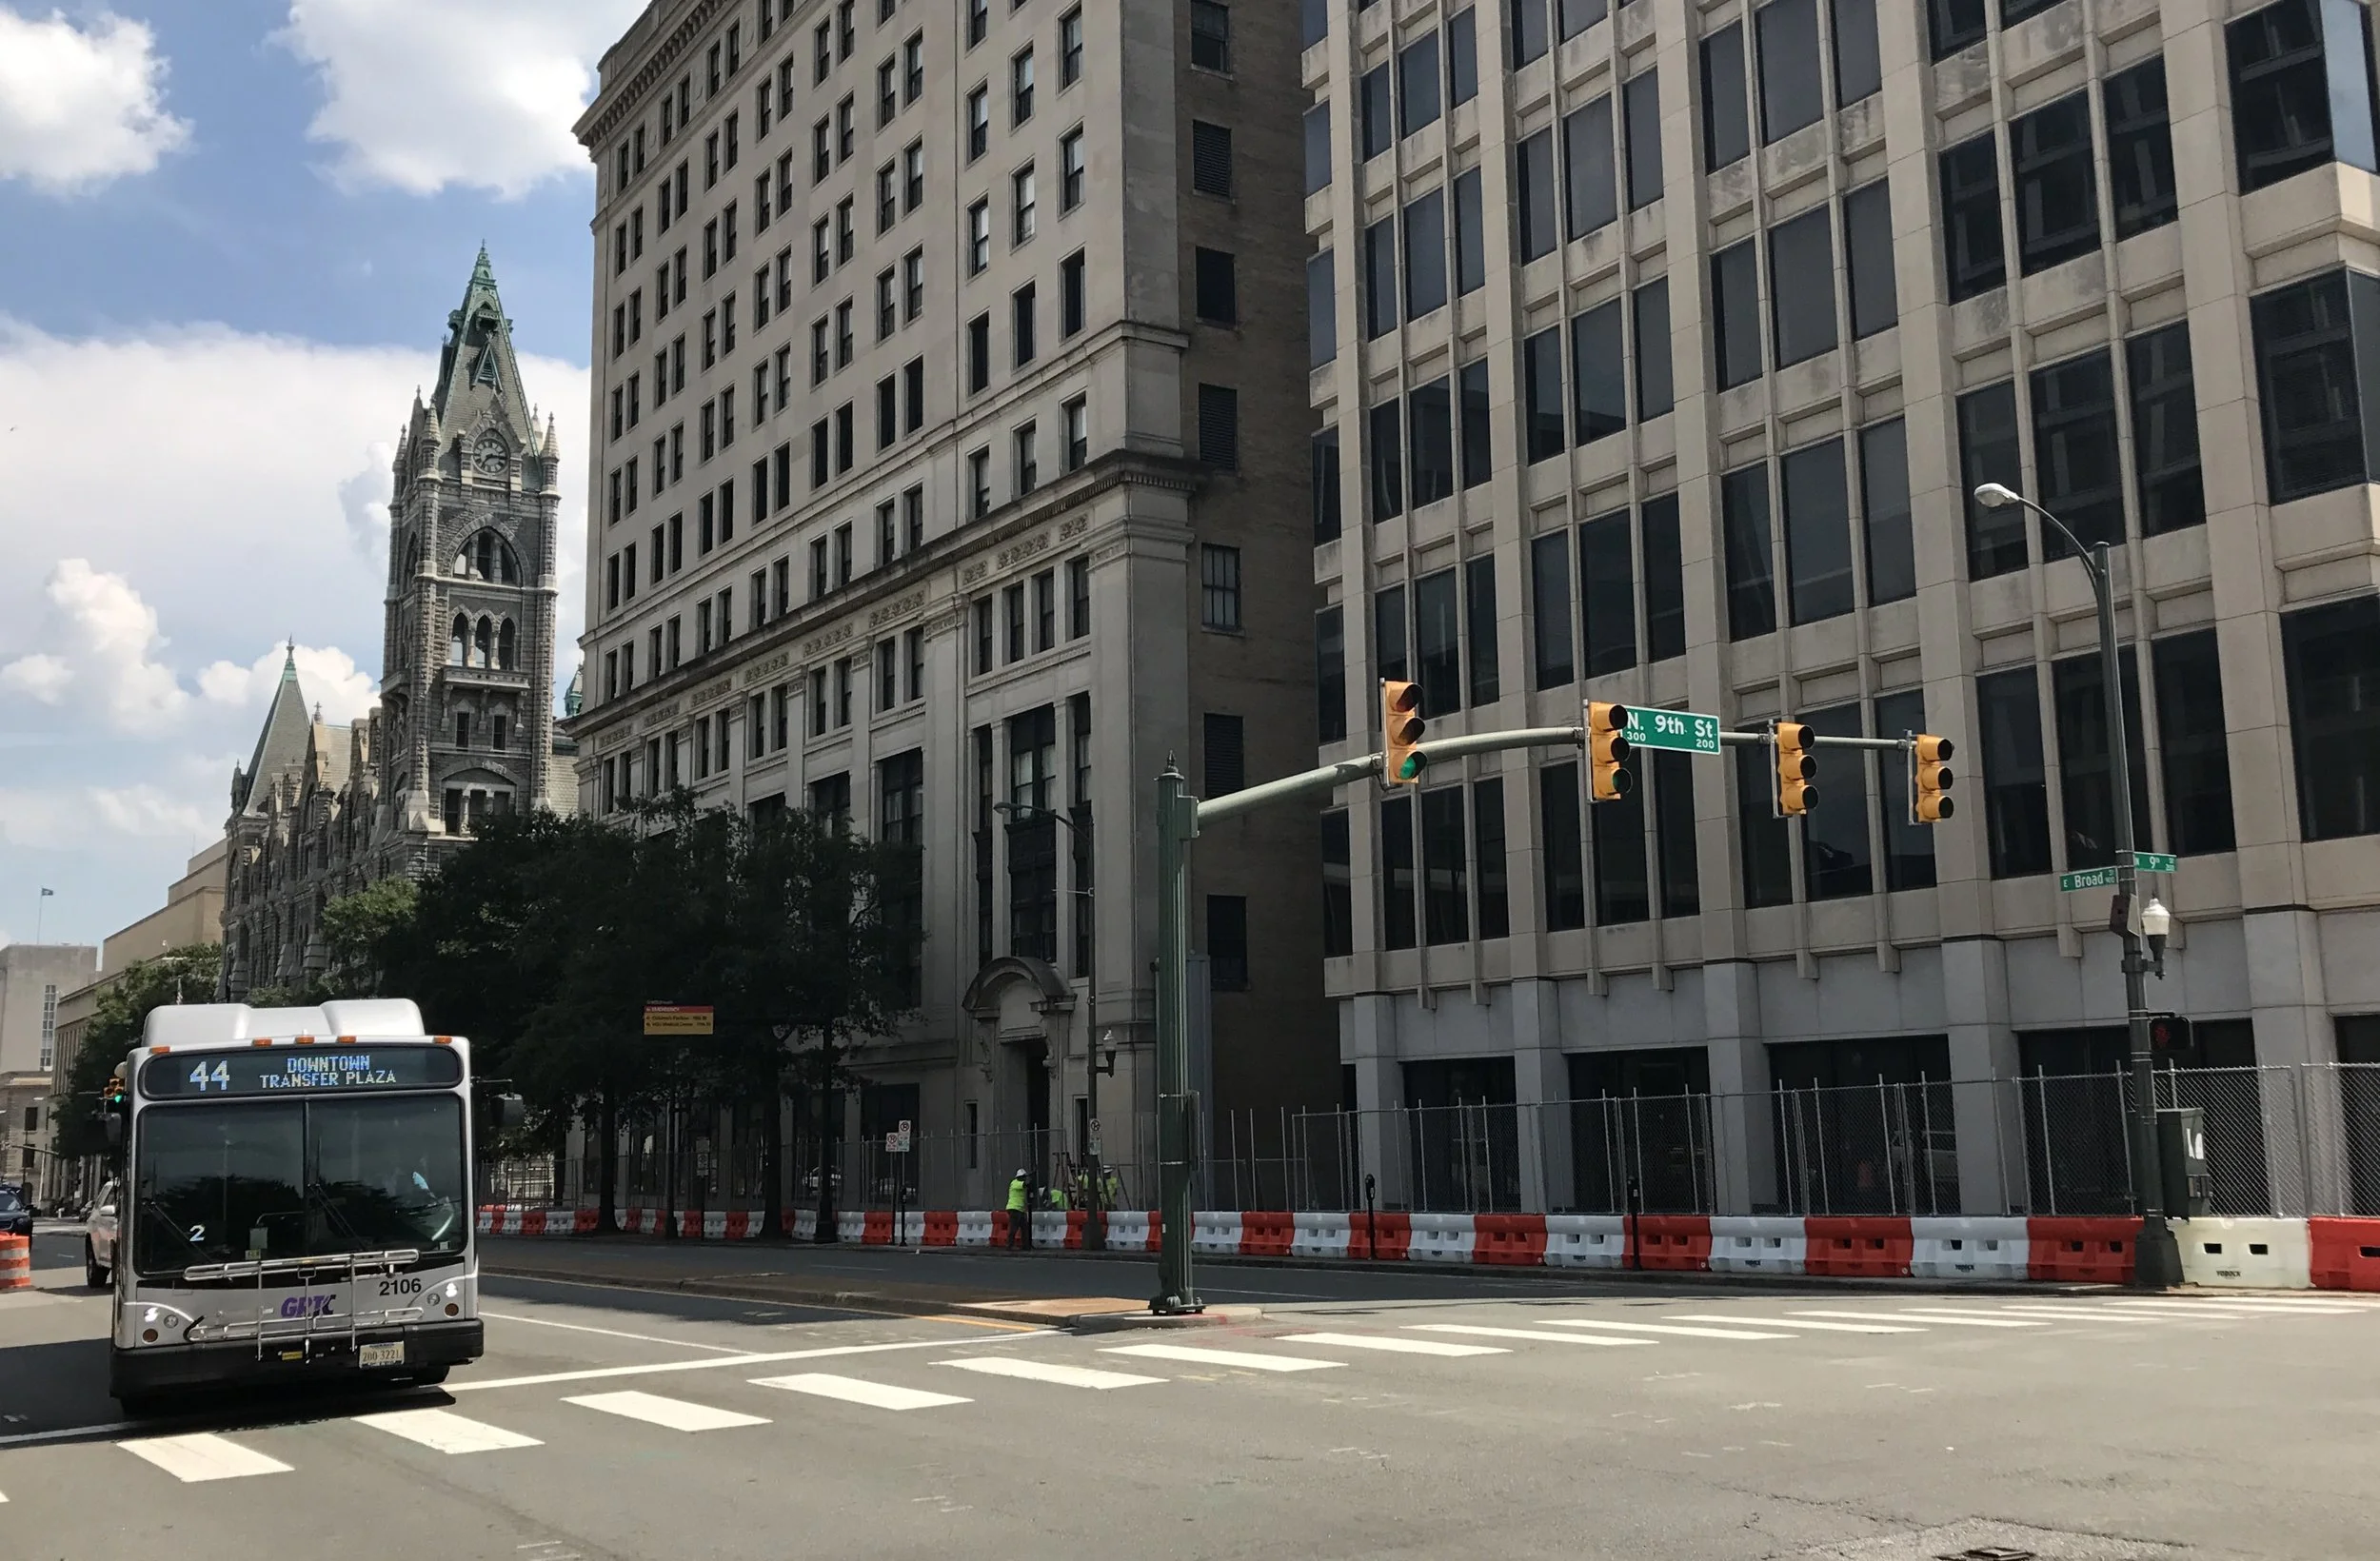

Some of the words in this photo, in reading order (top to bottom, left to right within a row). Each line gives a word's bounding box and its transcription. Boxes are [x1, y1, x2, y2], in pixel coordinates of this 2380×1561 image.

[1627, 712, 1644, 731] N.
[1655, 715, 1684, 735] 9th
[1695, 719, 1714, 738] St
[1626, 731, 1646, 741] 300
[1696, 739, 1715, 749] 200
[2063, 879, 2068, 888] E
[2074, 872, 2104, 889] Broad
[288, 1055, 370, 1074] DOWNTOWN
[189, 1059, 230, 1091] 44
[259, 1072, 339, 1089] TRANSFER
[346, 1069, 397, 1085] PLAZA
[189, 1224, 206, 1242] 2
[379, 1277, 422, 1296] 2106
